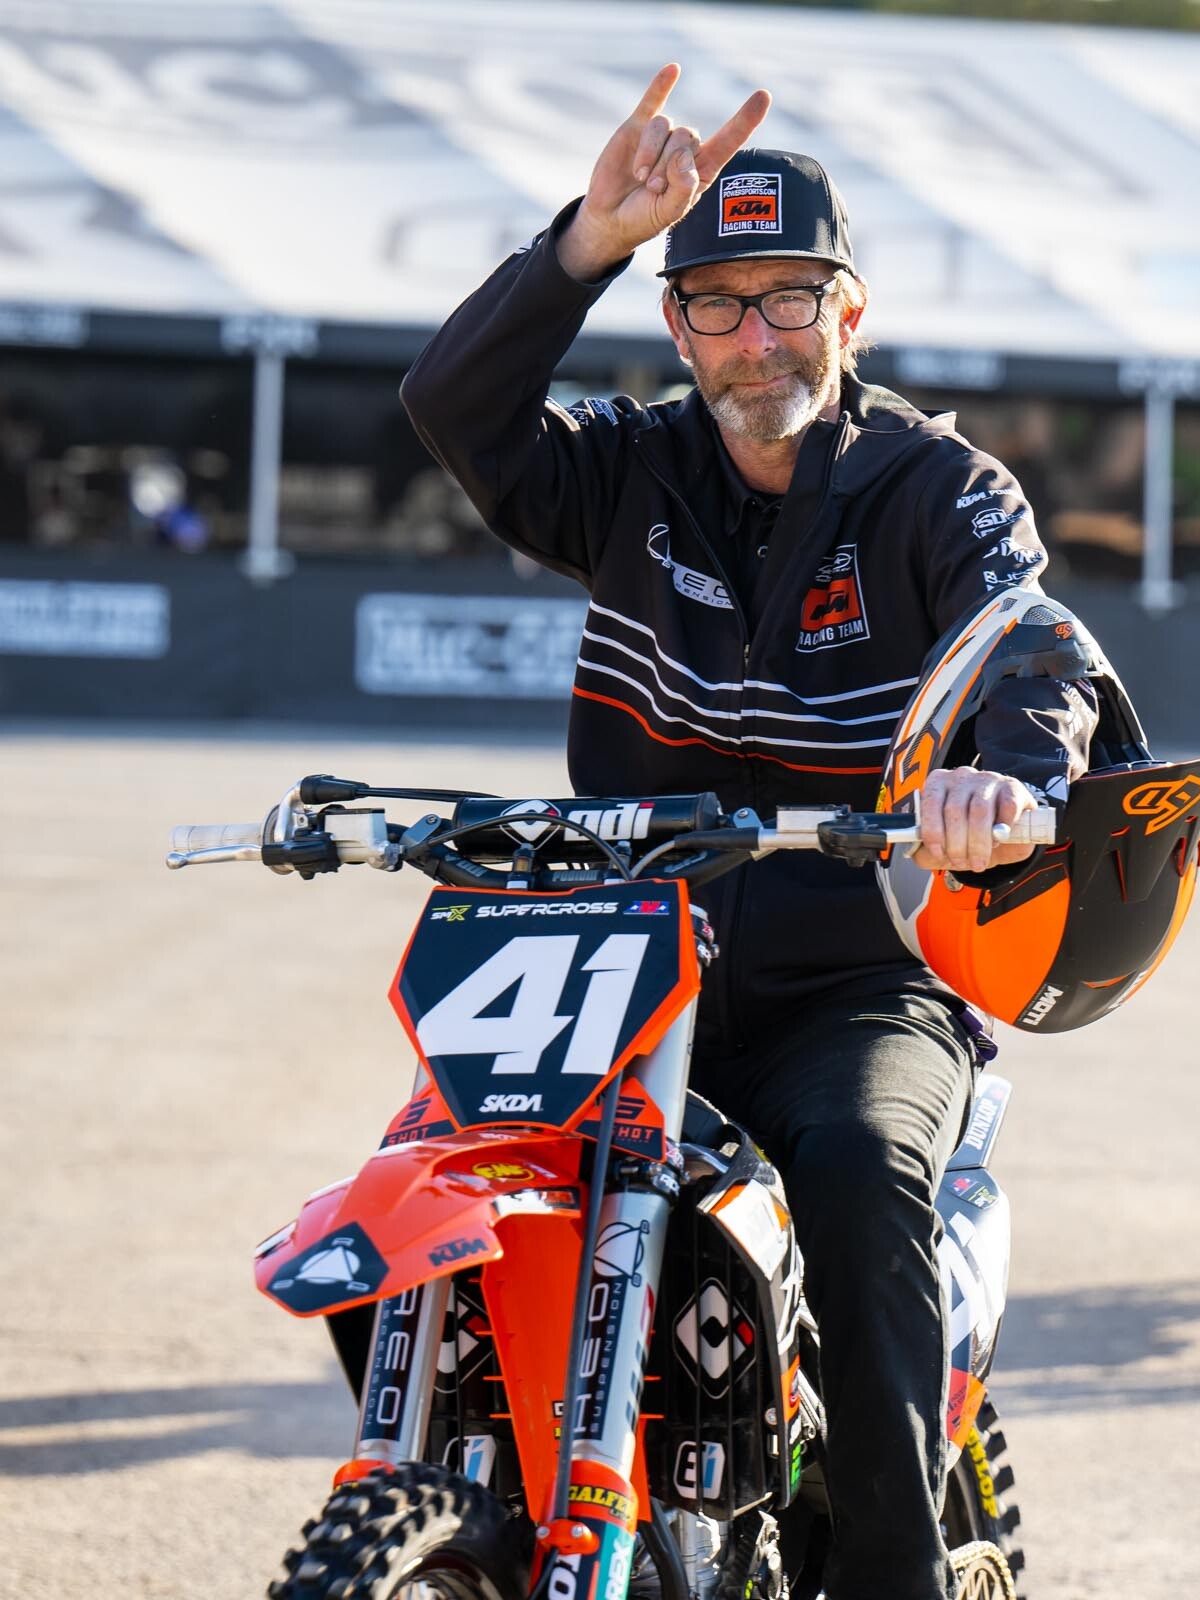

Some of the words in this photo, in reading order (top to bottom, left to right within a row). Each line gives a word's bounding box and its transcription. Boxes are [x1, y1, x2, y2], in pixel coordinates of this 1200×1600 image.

[723, 188, 777, 199] POWERSPORTS.COM
[728, 200, 772, 217] KTM
[723, 220, 752, 232] RACING
[754, 220, 777, 231] TEAM
[838, 619, 864, 638] TEAM
[475, 901, 619, 919] SUPERCROSS
[415, 934, 650, 1075] 41
[479, 1093, 543, 1113] SKDA
[964, 1097, 998, 1150] DUNLOP
[387, 1126, 430, 1148] SHOT
[612, 1126, 655, 1141] HOT
[428, 1238, 488, 1267] KTM
[365, 1298, 392, 1425] SPENSION
